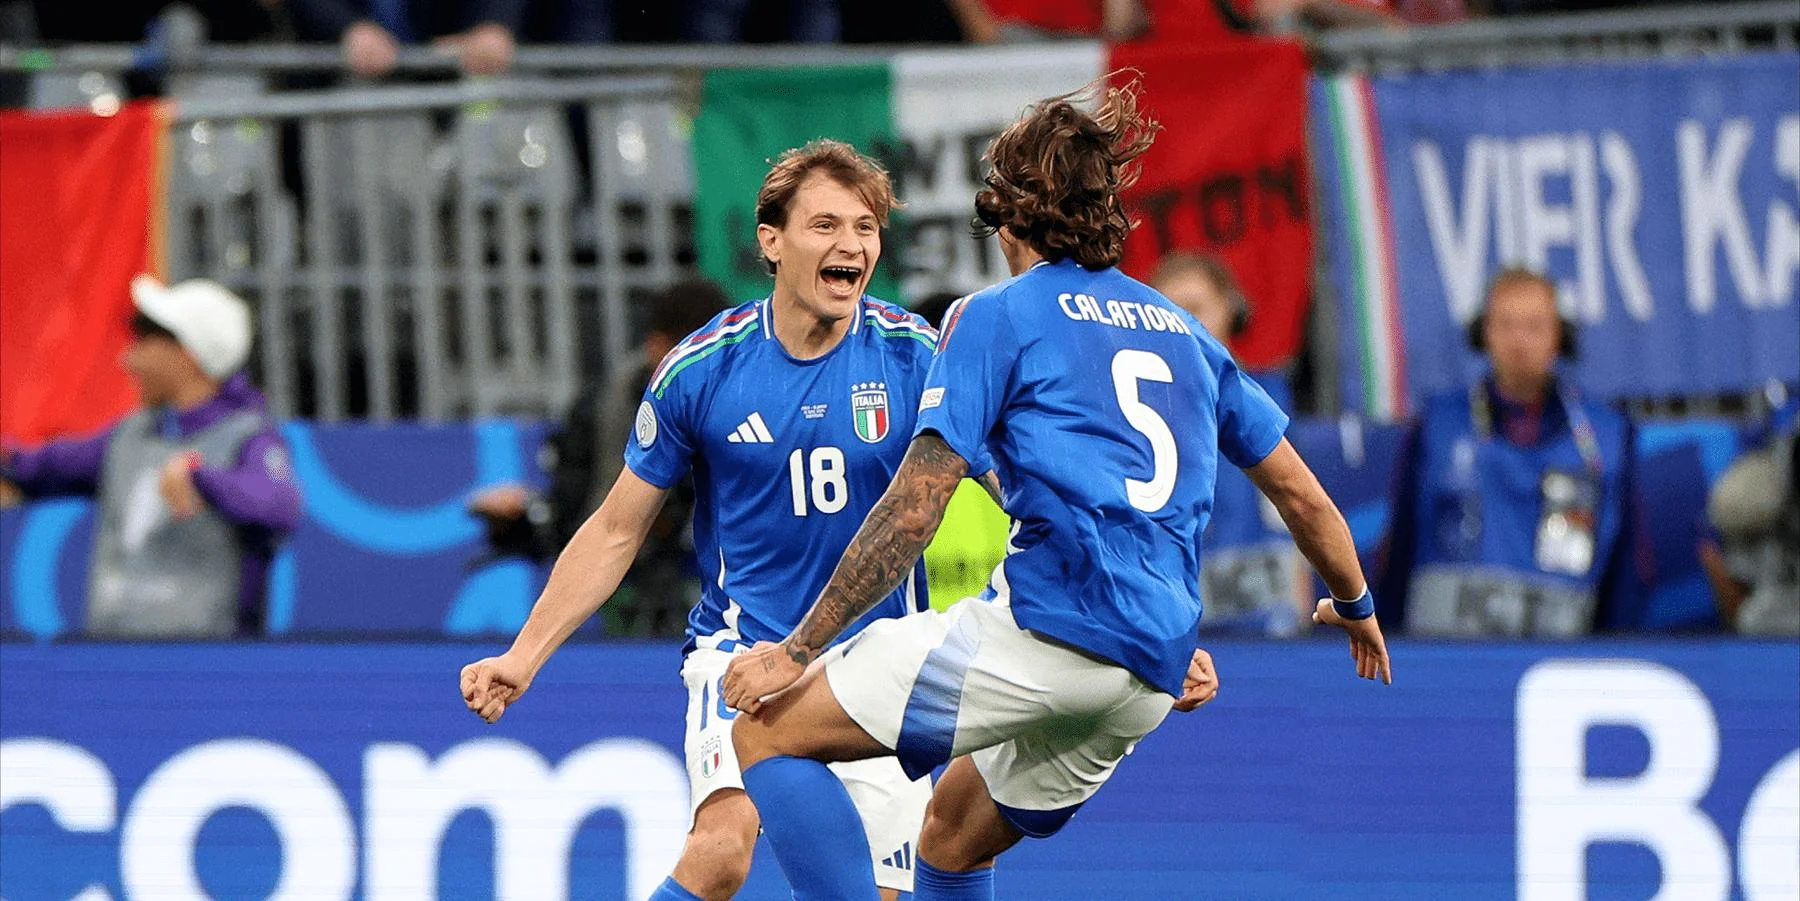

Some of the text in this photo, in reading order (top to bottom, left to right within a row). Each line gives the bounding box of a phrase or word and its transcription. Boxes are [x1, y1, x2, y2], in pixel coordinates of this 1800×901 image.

[1412, 131, 1655, 326] VIER
[1057, 293, 1192, 336] CALAFIORI
[855, 393, 885, 407] ITALIA
[1109, 348, 1177, 512] 5
[789, 446, 848, 516] 18
[1514, 657, 1800, 901] B
